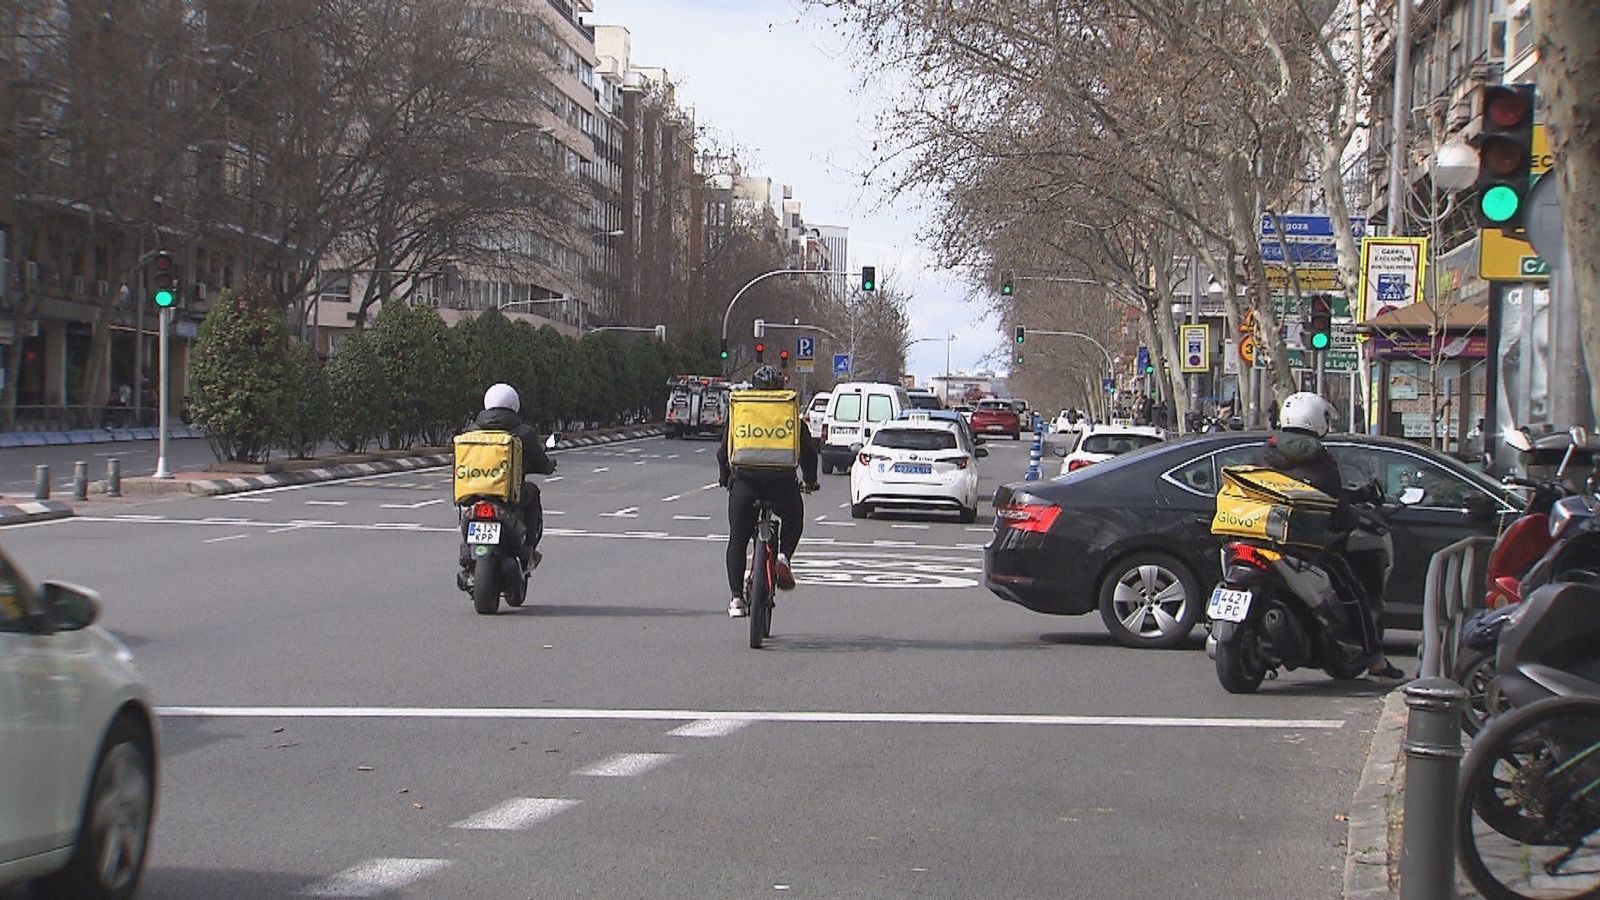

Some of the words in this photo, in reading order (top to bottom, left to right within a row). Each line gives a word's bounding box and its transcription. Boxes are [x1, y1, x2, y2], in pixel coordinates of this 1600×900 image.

[1263, 220, 1308, 231] Zagoza
[736, 423, 787, 439] Glovo
[456, 464, 501, 479] Glovo
[1217, 511, 1253, 528] Glovo
[1221, 591, 1248, 604] 4421
